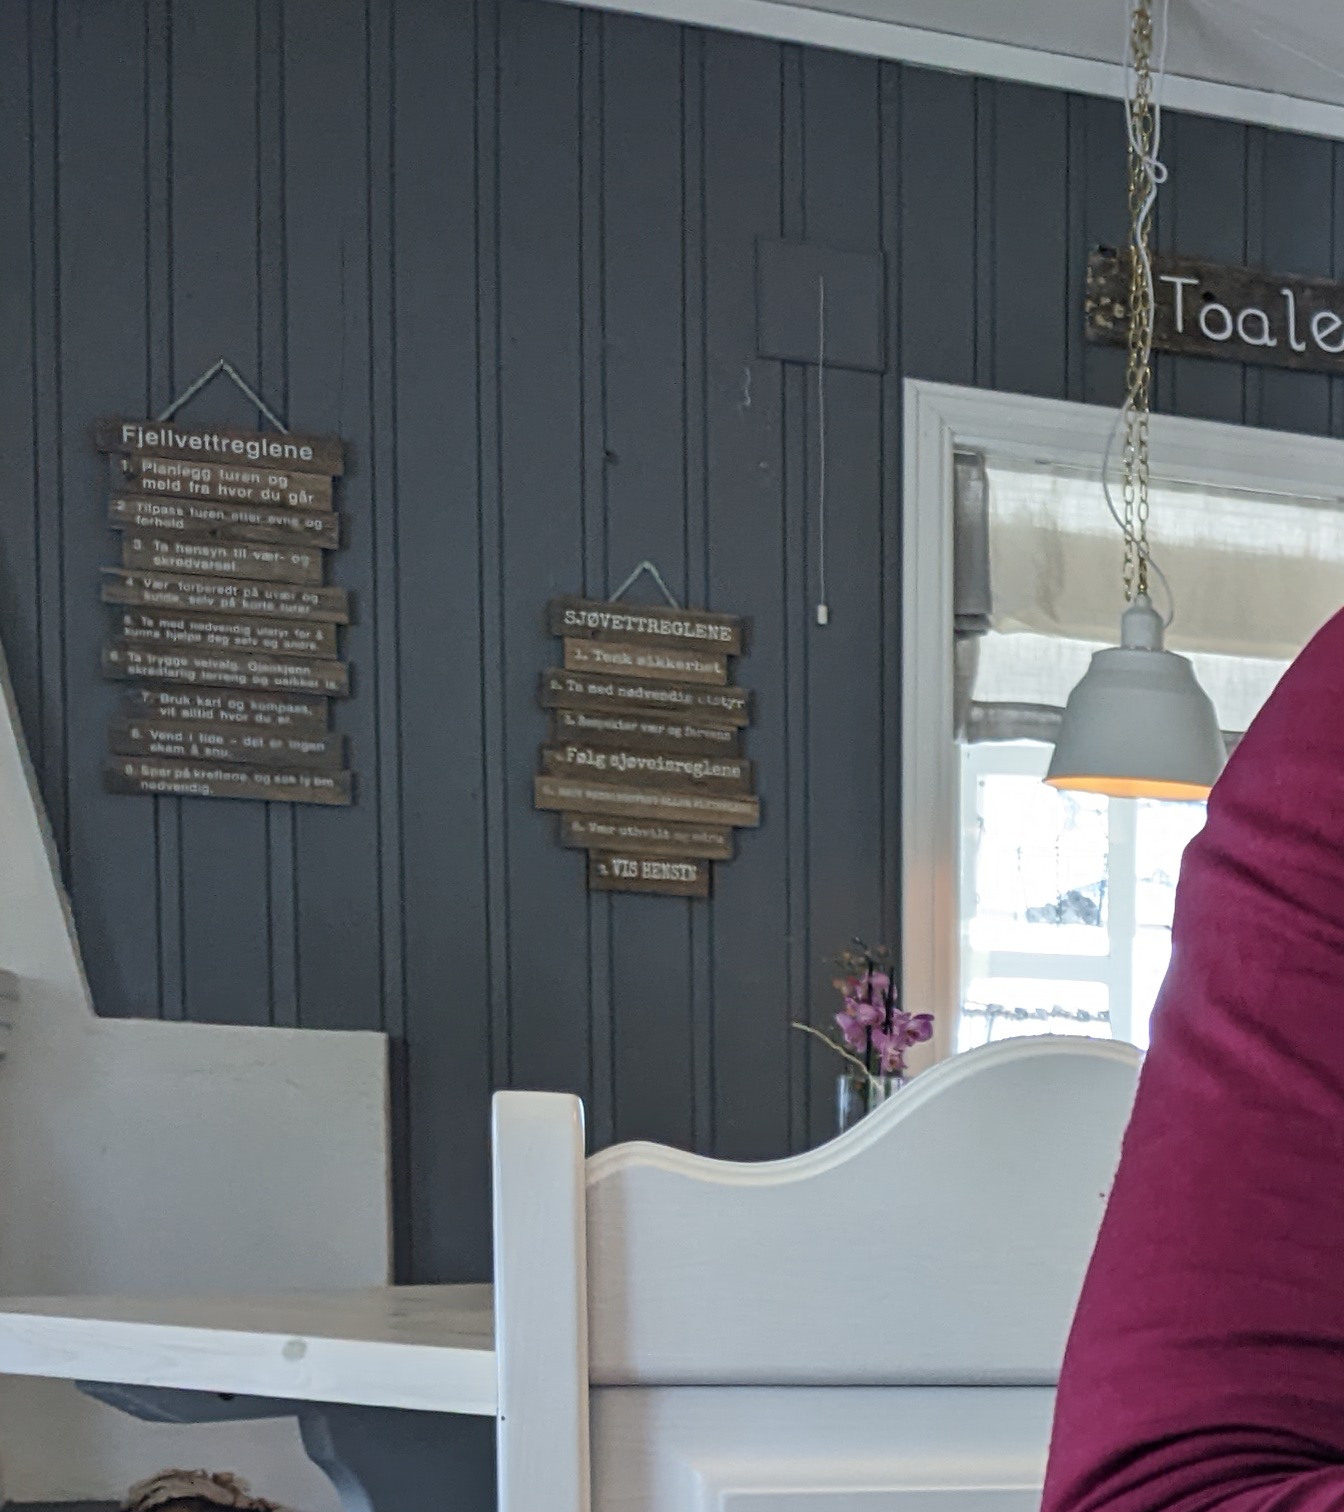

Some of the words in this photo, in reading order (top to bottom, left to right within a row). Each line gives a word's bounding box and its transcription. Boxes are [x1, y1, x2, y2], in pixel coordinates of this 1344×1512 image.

[121, 425, 313, 461] Fjellvettreglene
[142, 461, 211, 480] Planlegg
[219, 468, 260, 484] turen
[268, 475, 288, 489] og
[143, 477, 181, 492] meld
[189, 481, 210, 496] fra
[218, 483, 252, 498] hvor
[261, 487, 280, 502] du
[289, 489, 315, 506] går
[190, 507, 224, 520] turen
[305, 518, 323, 531] og
[154, 540, 169, 552] Ta
[176, 542, 227, 558] hensyn
[233, 547, 247, 559] til
[292, 554, 309, 568] og
[144, 578, 168, 590] Vær
[178, 580, 240, 596] forberedt
[243, 585, 259, 600] på
[302, 592, 318, 605] og
[220, 595, 236, 610] på
[141, 616, 154, 628] Ta
[159, 618, 184, 630] med
[190, 620, 250, 637] nødvendig
[294, 628, 310, 640] for
[564, 609, 732, 642] SJØVETTREGLENE
[208, 633, 229, 647] deg
[263, 638, 278, 650] og
[127, 651, 142, 663] Ta
[594, 649, 633, 665] Tenk
[637, 654, 722, 674] sikkerhet
[252, 673, 269, 687] og
[565, 679, 584, 691] Ta
[588, 681, 613, 695] med
[159, 692, 190, 706] Bruk
[196, 695, 222, 709] kart
[228, 698, 245, 713] og
[220, 710, 248, 723] hvor
[255, 713, 272, 725] du
[150, 729, 183, 742] Vend
[199, 732, 224, 745] tide
[243, 735, 264, 749] det
[150, 743, 184, 755] skam
[566, 747, 606, 770] Følg
[609, 752, 741, 779] sjøveisreglene
[140, 765, 172, 779] Spar
[174, 767, 191, 781] på
[253, 773, 271, 786] og
[314, 776, 334, 788] om
[612, 857, 639, 879] VIS
[641, 861, 697, 882] HENSYN
